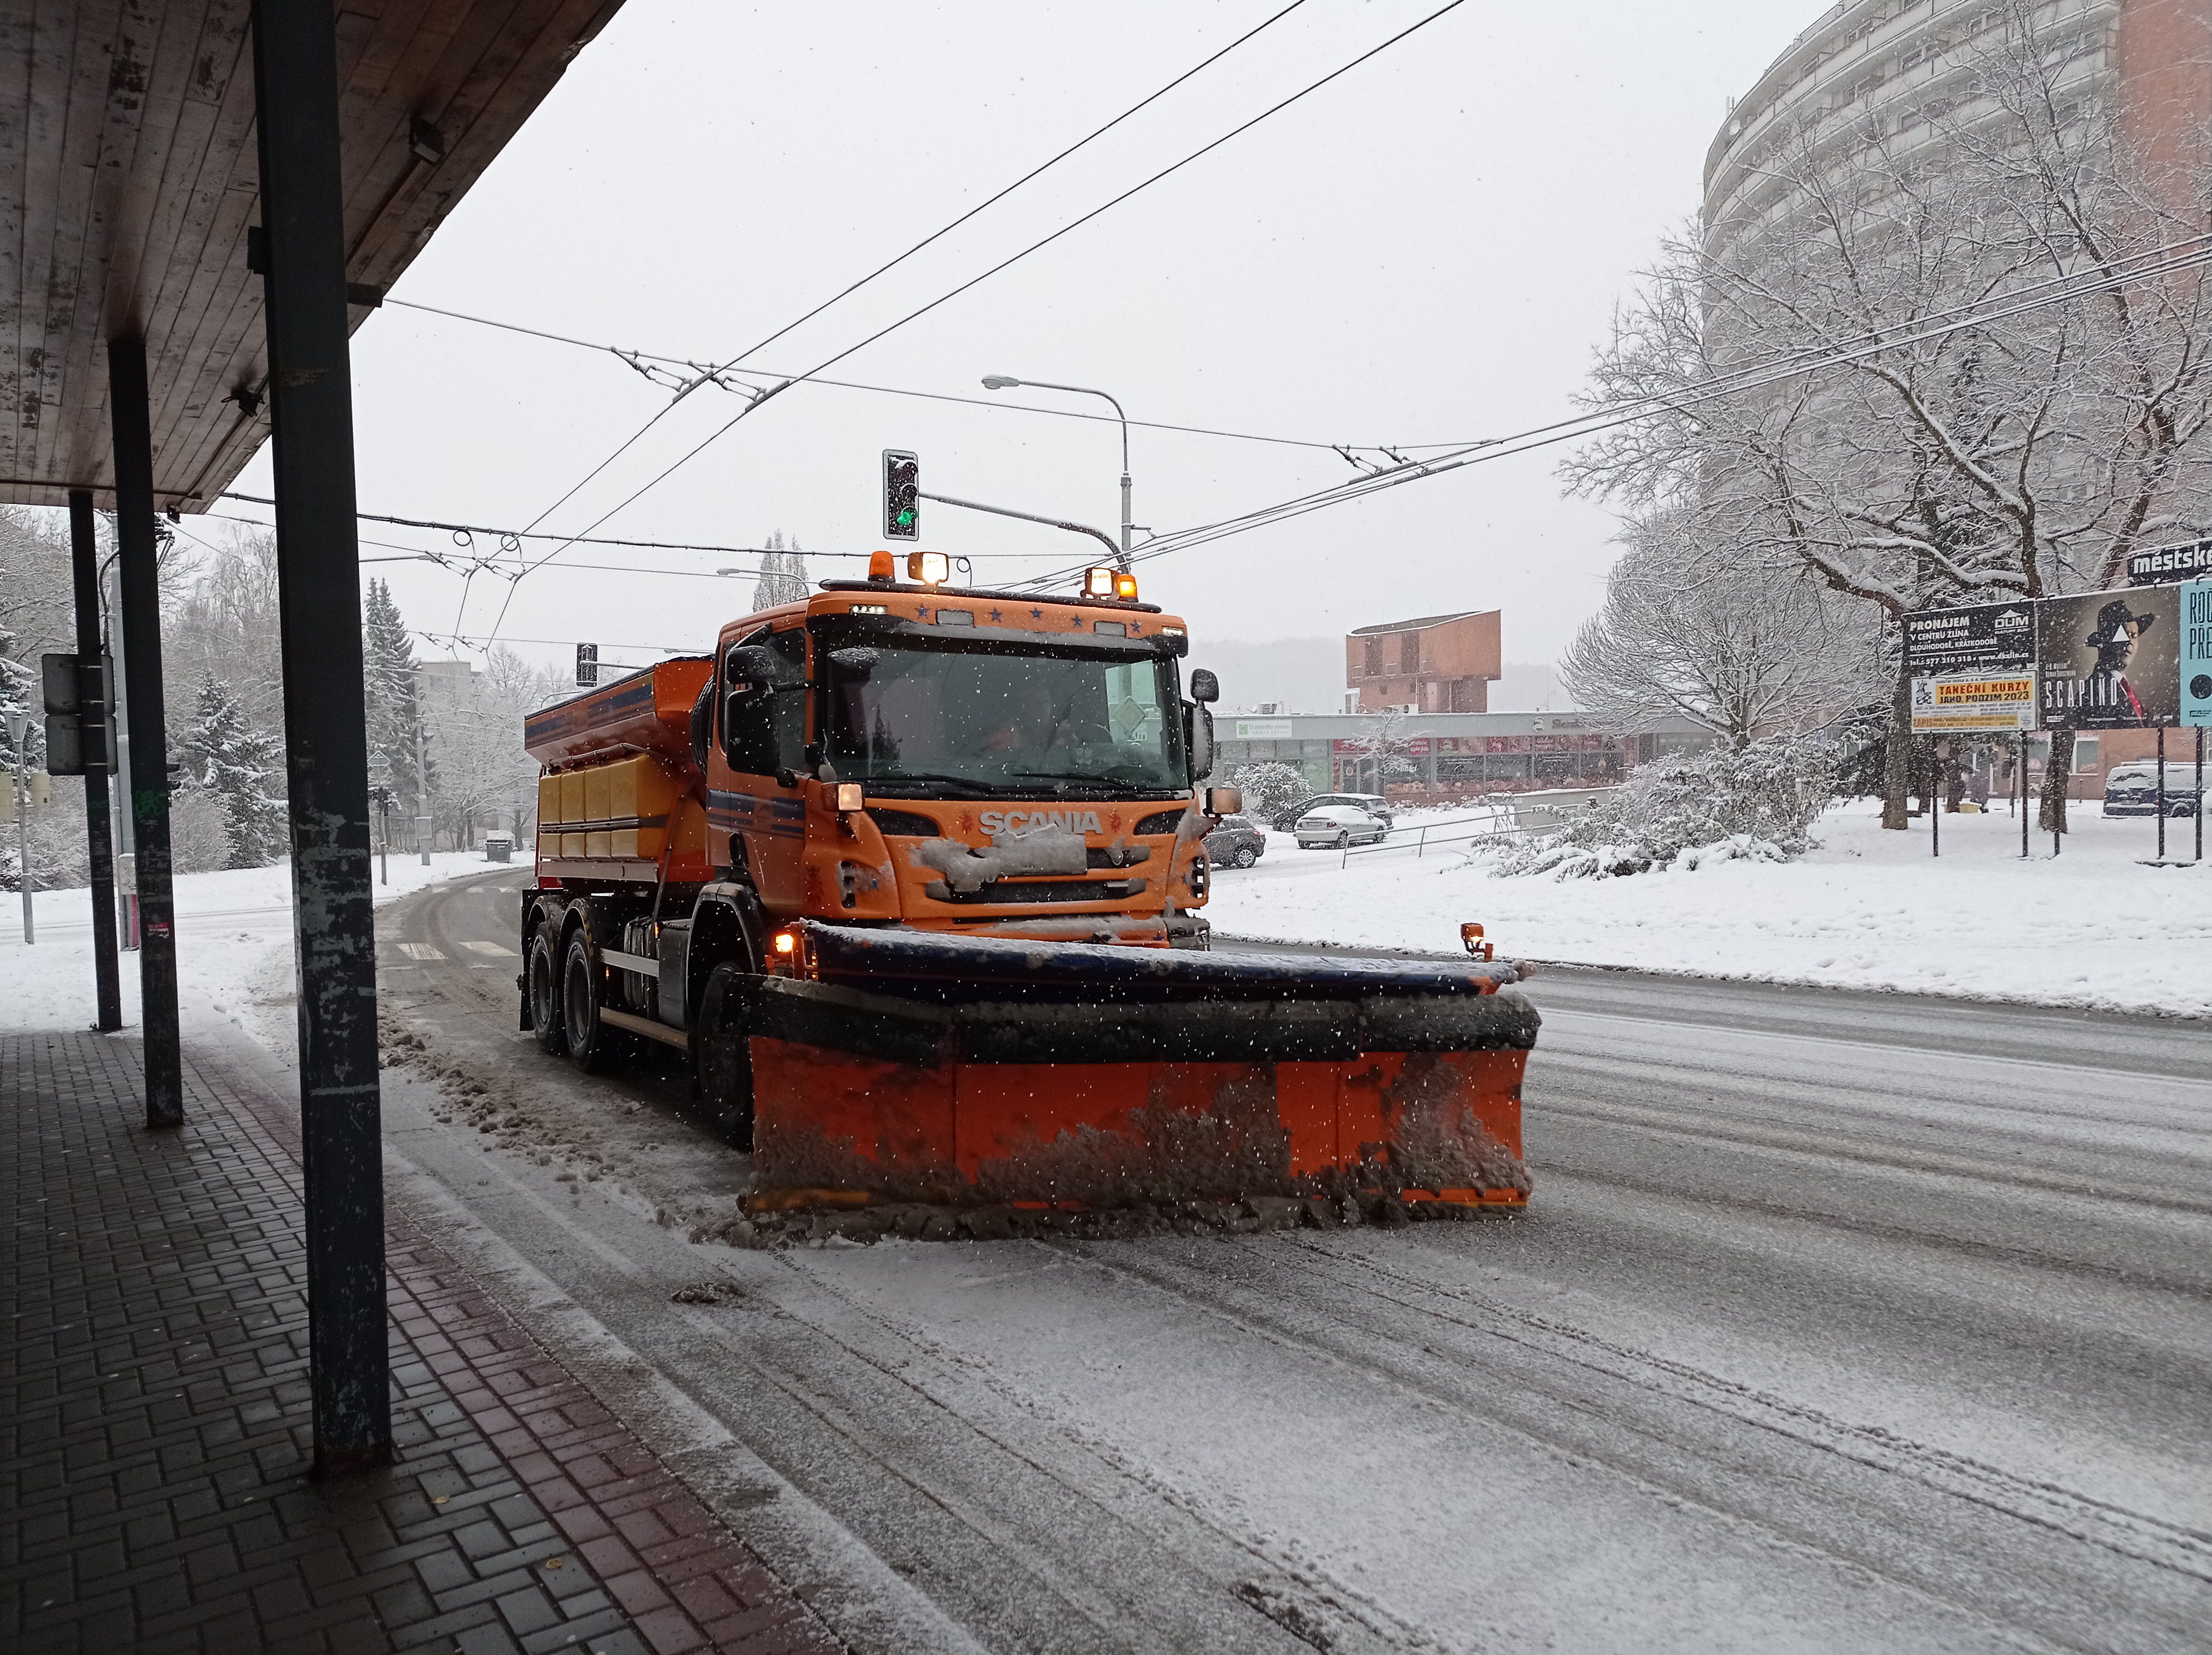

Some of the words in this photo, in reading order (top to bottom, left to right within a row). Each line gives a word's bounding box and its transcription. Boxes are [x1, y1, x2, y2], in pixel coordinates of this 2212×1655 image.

[1910, 616, 1970, 631] PRONÁJEM
[1918, 631, 1945, 641] CENTRU
[1947, 629, 1969, 638] ZLÍNA
[1955, 637, 1997, 648] KRÁTKODOBĚ
[1939, 683, 1986, 695] TANEČNÍ
[1991, 681, 2029, 693] KURZY
[2046, 677, 2117, 708] SCAPINO
[1965, 693, 2002, 702] PODZIM
[2004, 691, 2029, 701] 2023
[979, 811, 1103, 835] SCANIA
